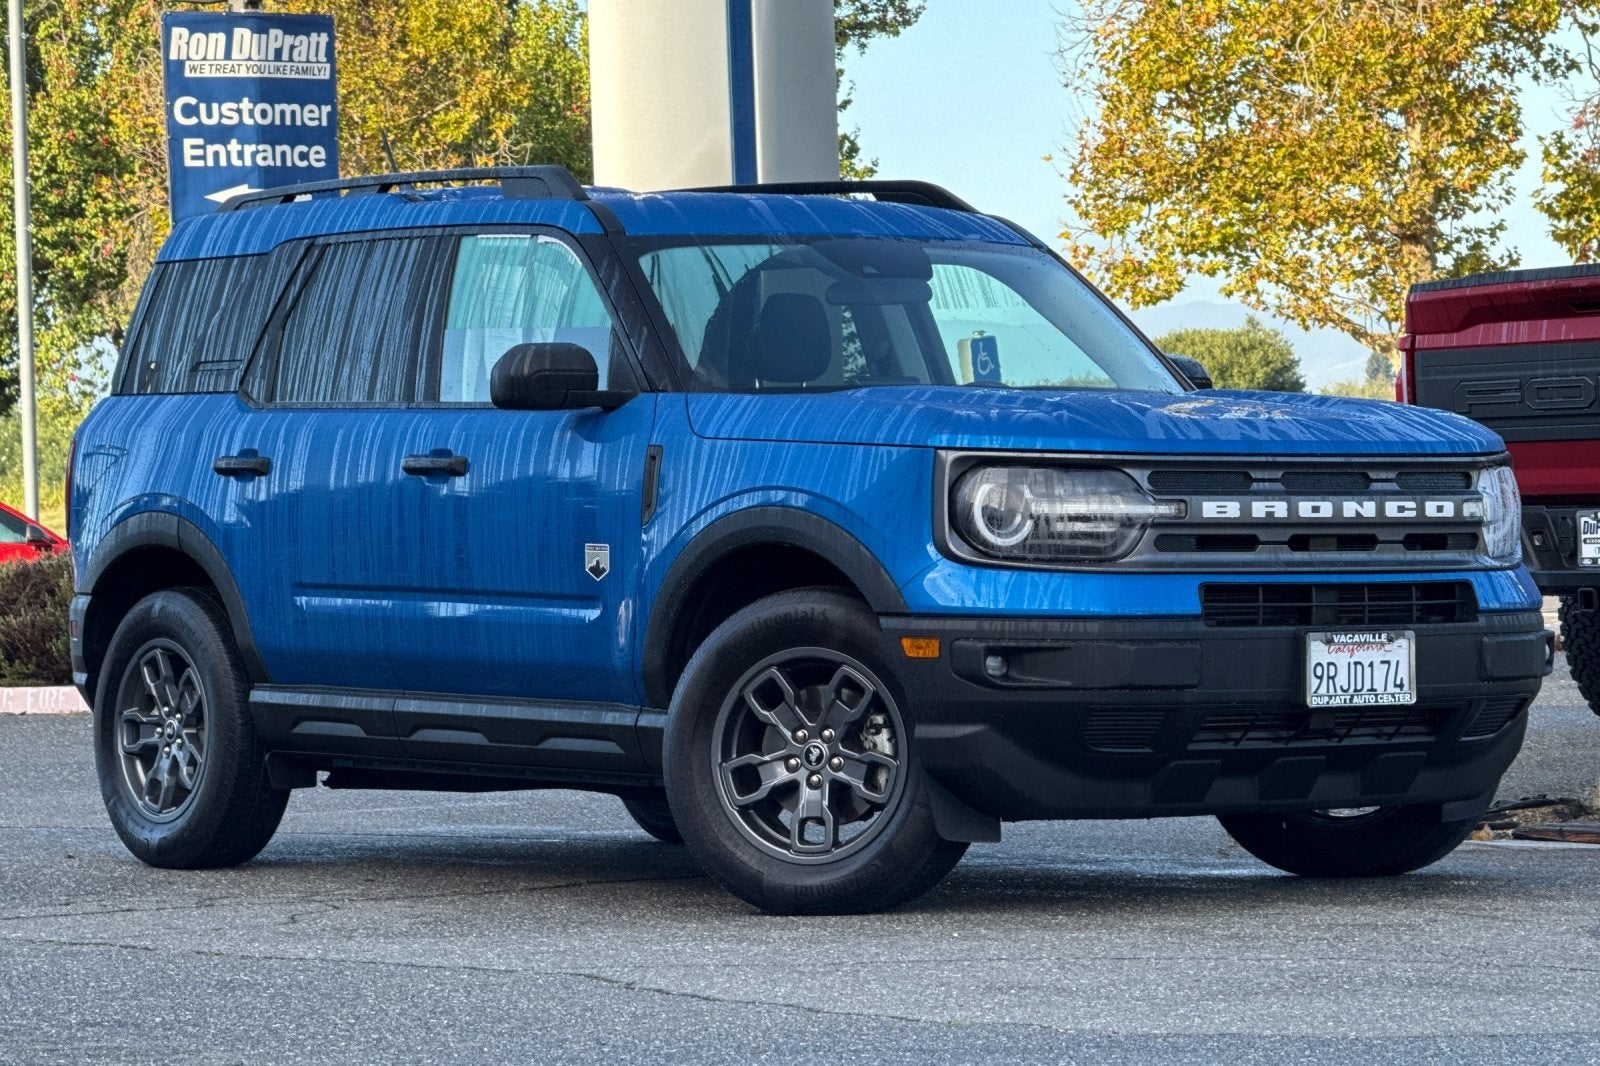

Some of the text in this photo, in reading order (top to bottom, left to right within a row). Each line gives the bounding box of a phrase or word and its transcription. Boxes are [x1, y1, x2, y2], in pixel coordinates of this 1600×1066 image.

[169, 27, 329, 62] Ron DuPratt
[188, 63, 327, 77] WE TREAT YOU LIKE FAMILY!
[173, 96, 332, 127] Customer
[183, 138, 327, 168] Entrance
[1453, 376, 1600, 412] FO
[1201, 501, 1455, 519] BRONCO
[1333, 633, 1388, 643] VACAVILLE
[1327, 643, 1393, 658] California
[1313, 660, 1405, 694] 9RJD174
[1312, 693, 1411, 705] DUPRATT AUTO CENTER
